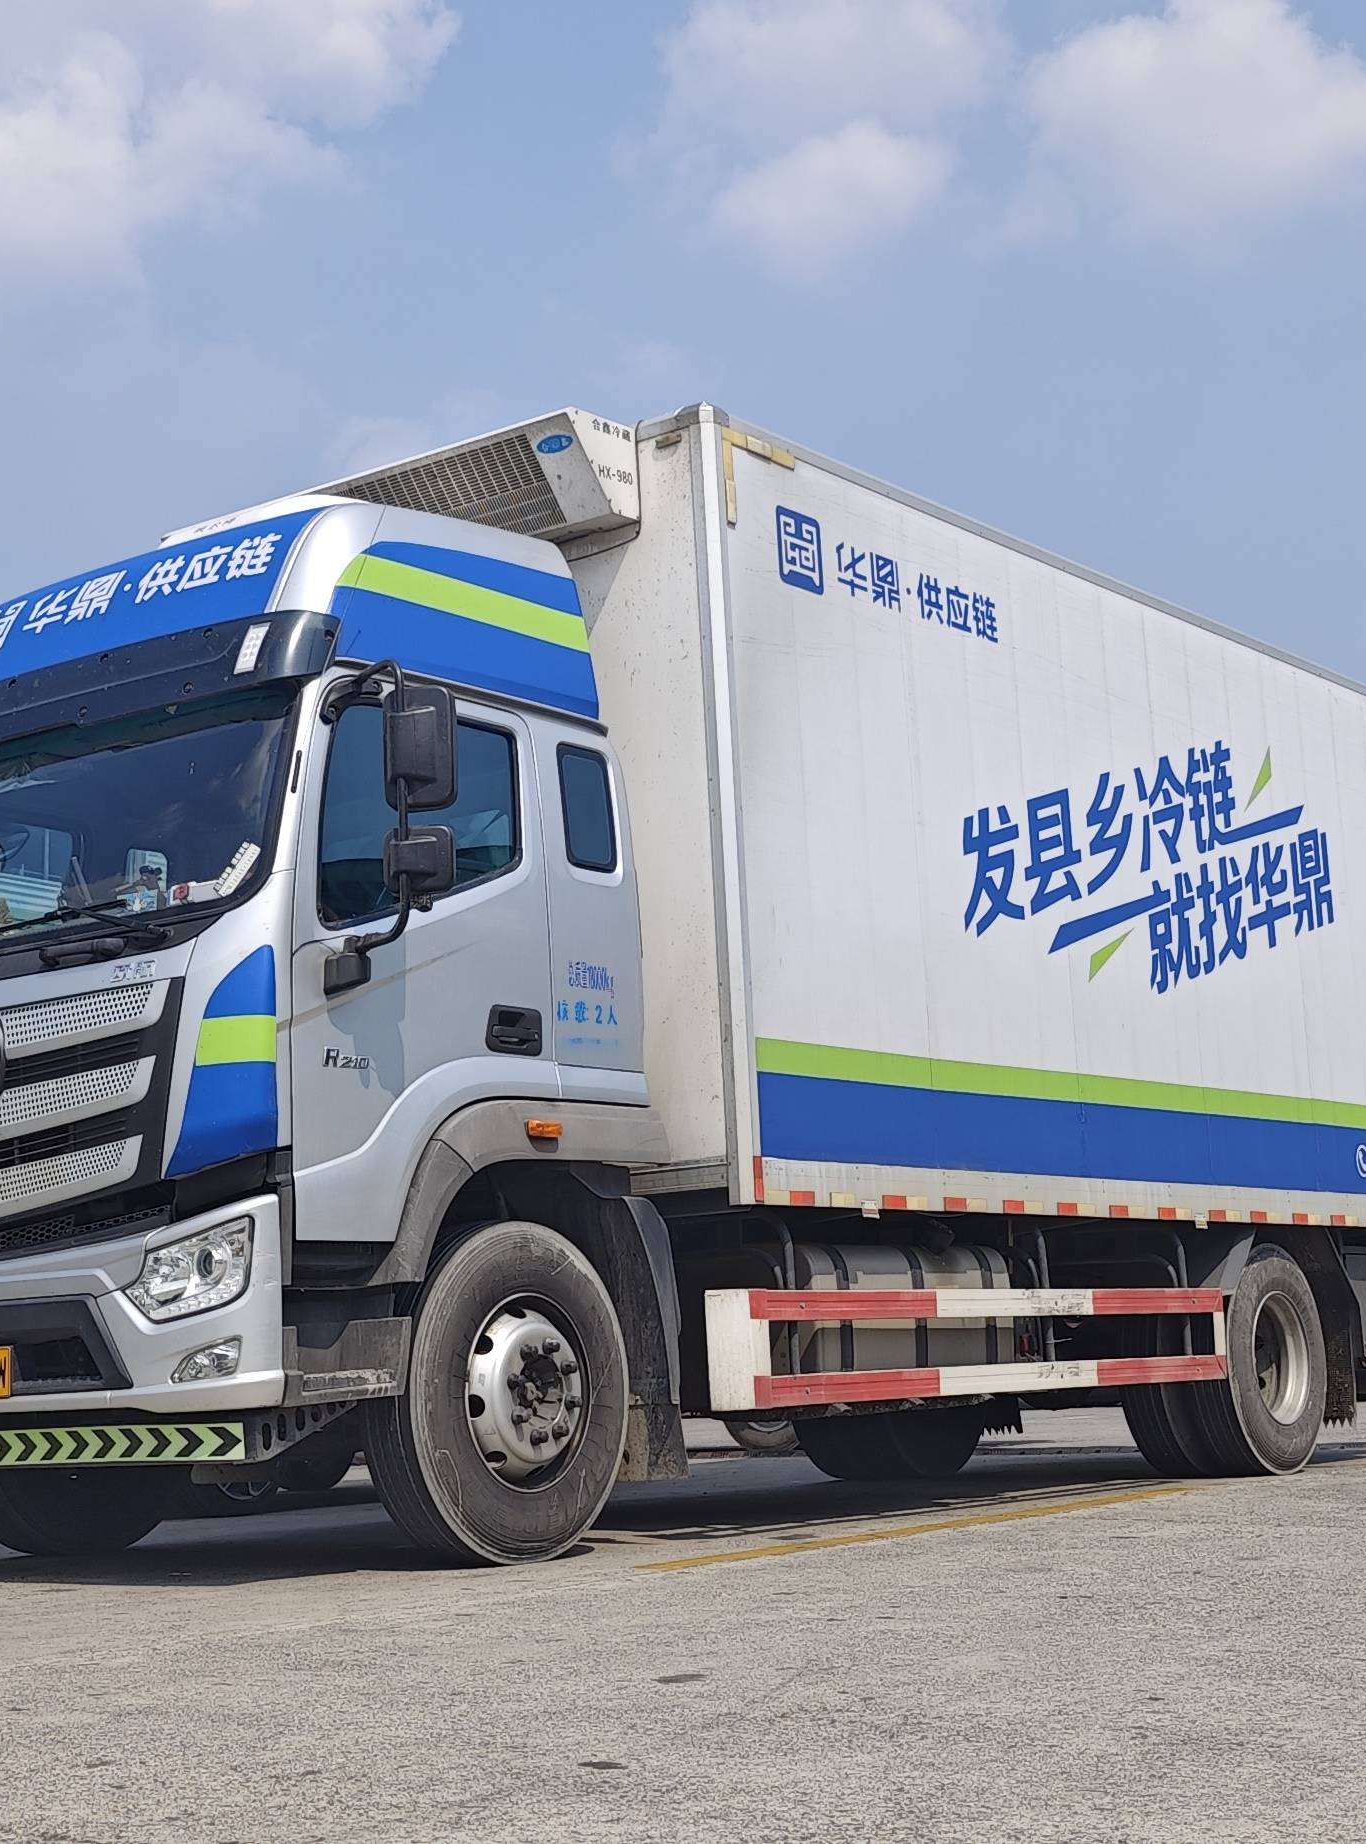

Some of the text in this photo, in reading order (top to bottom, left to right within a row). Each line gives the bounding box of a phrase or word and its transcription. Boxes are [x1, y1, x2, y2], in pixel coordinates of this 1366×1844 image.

[598, 464, 633, 486] HX-980
[962, 740, 1236, 938] 发县乡冷链
[1147, 828, 1335, 994] 就找华鼎
